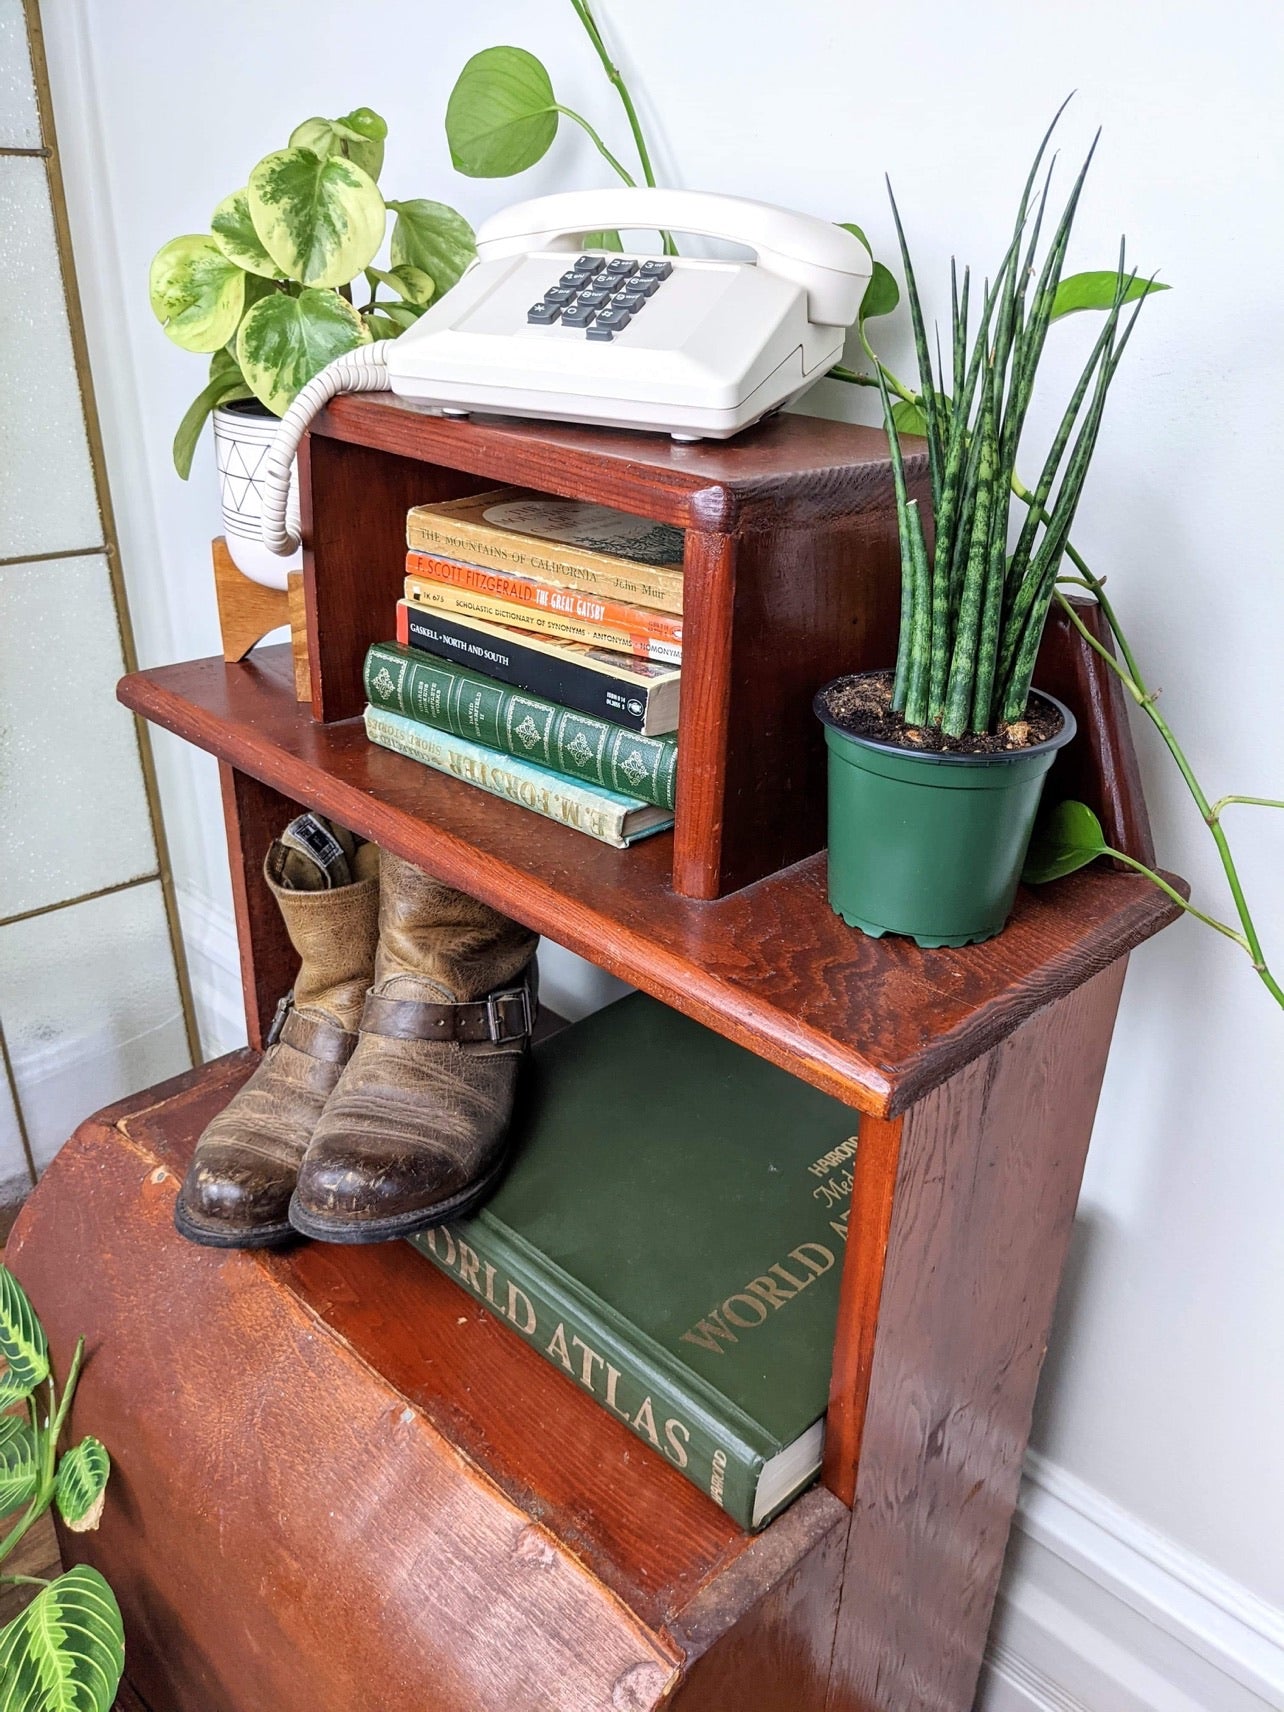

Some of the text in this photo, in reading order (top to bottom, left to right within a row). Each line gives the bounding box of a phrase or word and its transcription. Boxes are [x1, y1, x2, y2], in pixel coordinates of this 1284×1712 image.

[417, 557, 606, 621] F. SCOTT FITZGERALD THE GREAT GATSBY
[420, 528, 666, 600] THE MOUNTAINS OF CALIFORNIA John Muir
[410, 623, 509, 666] GASKELL NORTH AND SOUTH
[455, 600, 493, 615] SCHOLASTIC
[495, 608, 534, 625] DICTIONARY
[536, 618, 546, 627] OF
[547, 621, 586, 636] SYNONYMS
[593, 631, 633, 647] ANTONYMS
[367, 719, 442, 756] SHORT STORIES
[448, 750, 608, 837] E. M. FORSTER
[679, 1242, 836, 1354] WORLD
[414, 1224, 691, 1469] ORLD ATLAS
